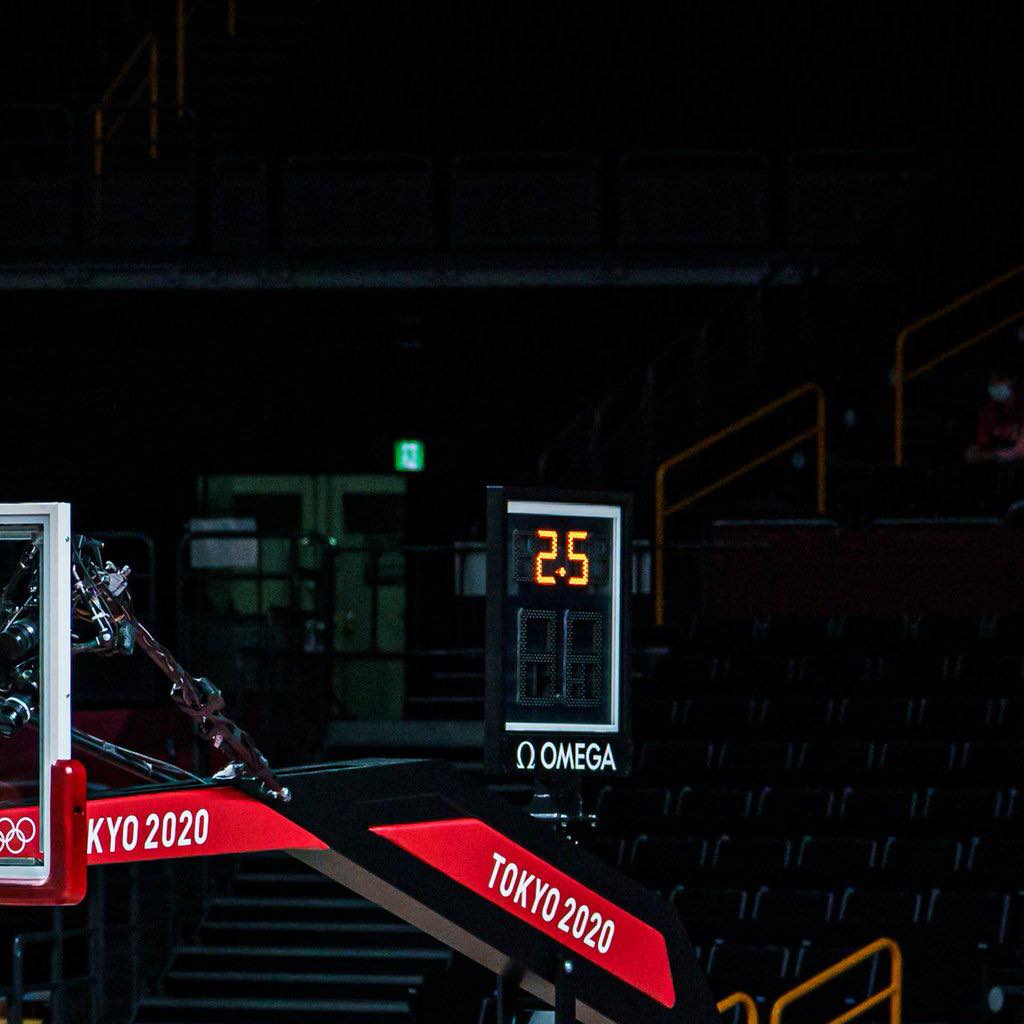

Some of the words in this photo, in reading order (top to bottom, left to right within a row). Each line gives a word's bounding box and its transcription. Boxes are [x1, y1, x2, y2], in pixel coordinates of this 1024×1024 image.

[535, 529, 589, 585] 2.5
[540, 742, 617, 771] OMEGA
[86, 815, 139, 855] KYO
[144, 808, 209, 849] 2020
[488, 852, 560, 922] TOKYO
[557, 897, 615, 954] 2020
